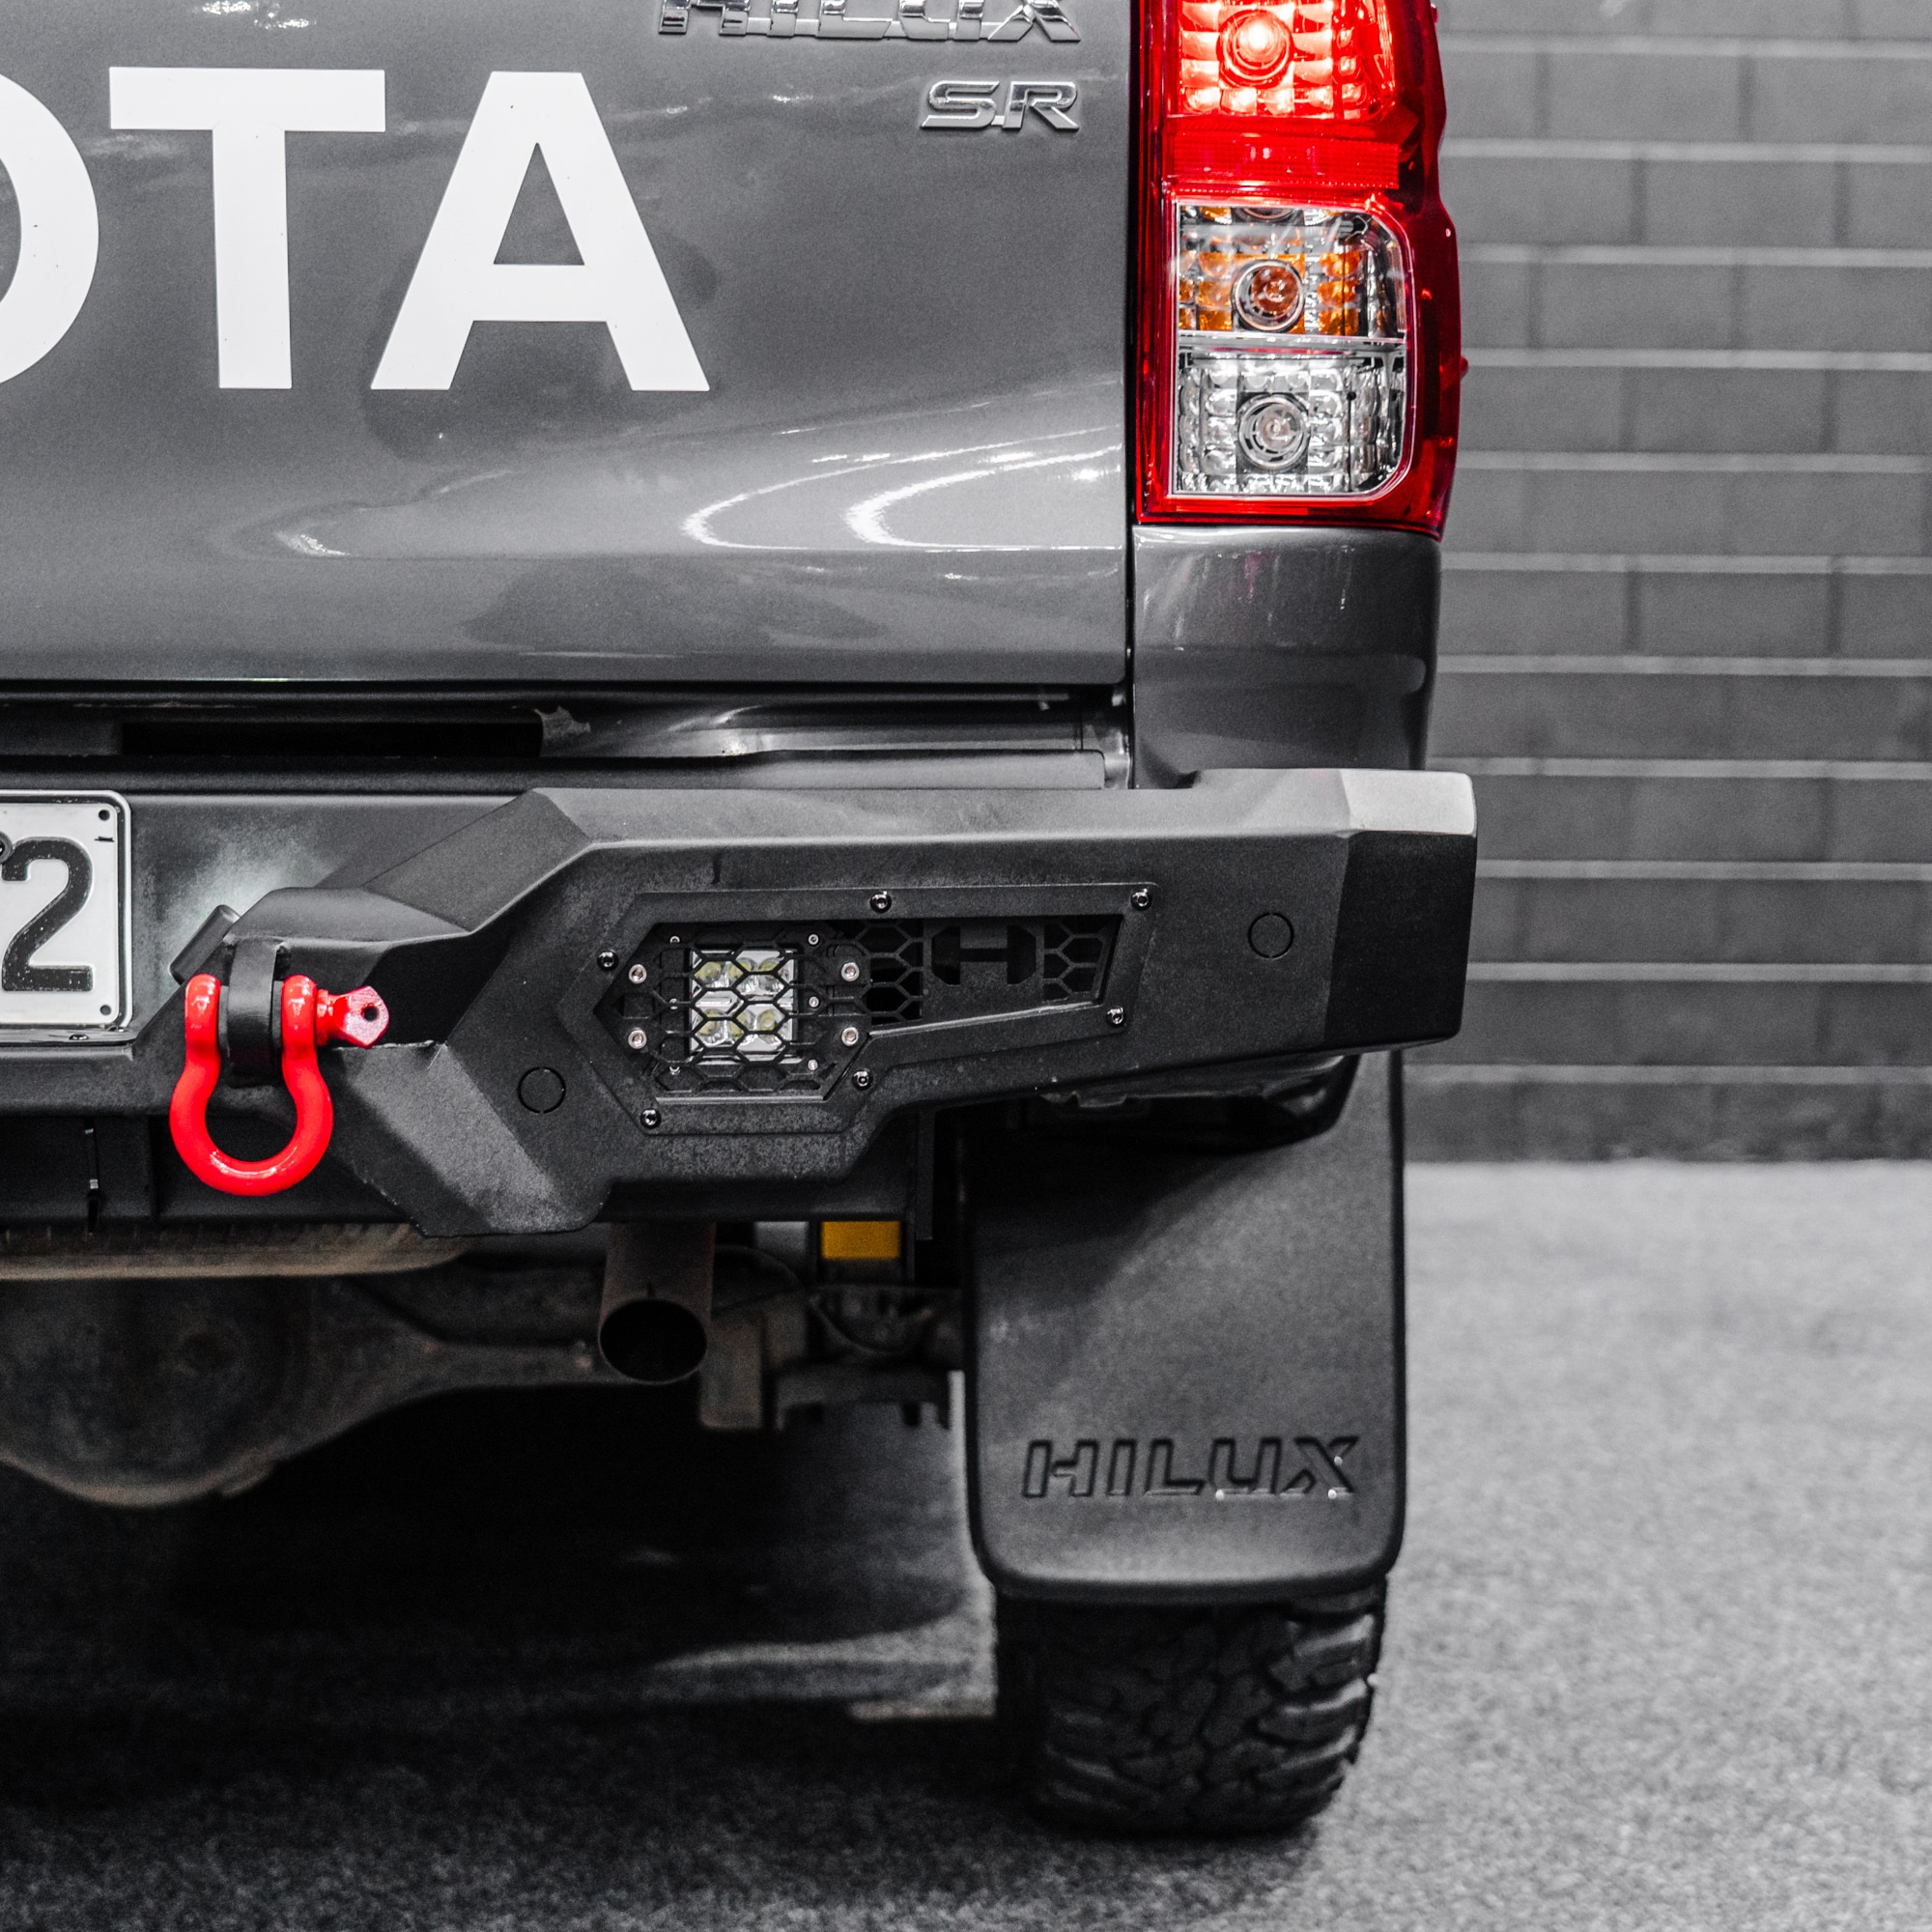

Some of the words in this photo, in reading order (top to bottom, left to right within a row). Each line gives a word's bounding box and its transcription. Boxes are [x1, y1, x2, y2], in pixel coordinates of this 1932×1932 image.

[921, 80, 1080, 130] SR
[1, 837, 93, 992] 2
[1021, 1435, 1360, 1499] HILUX
